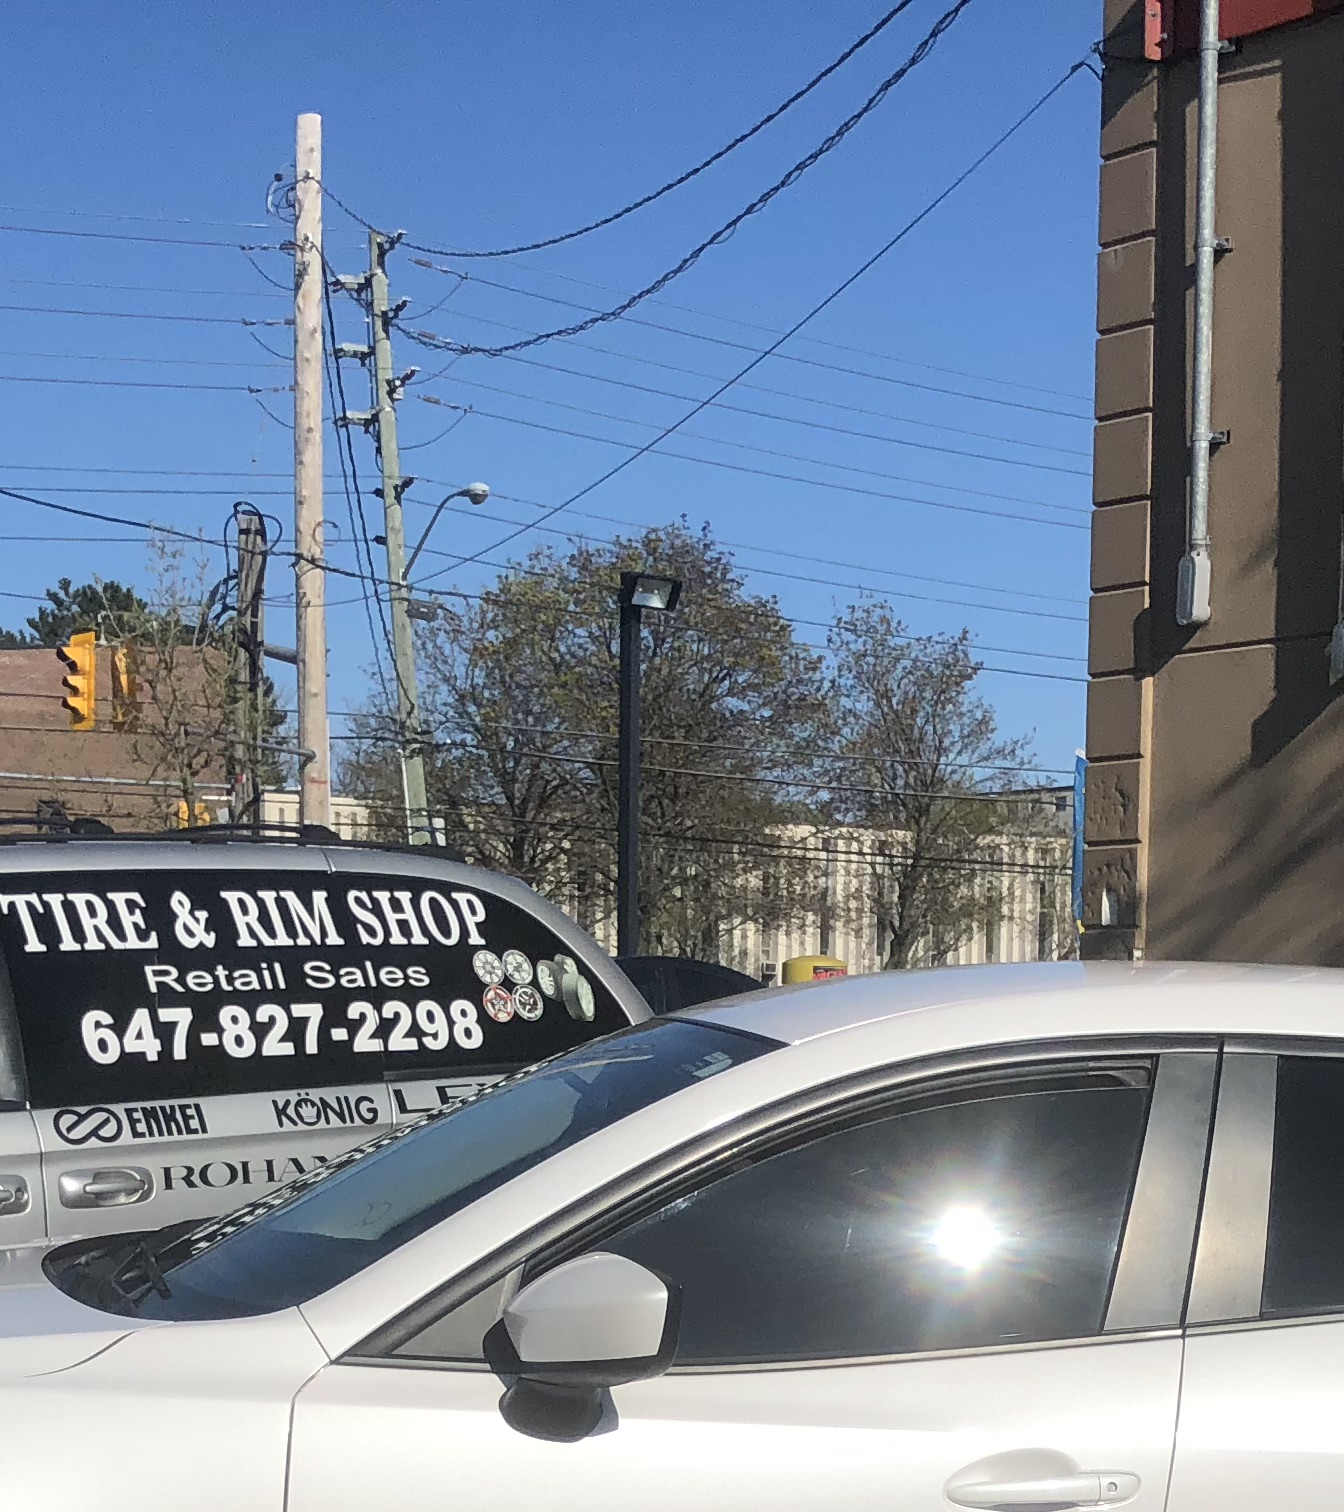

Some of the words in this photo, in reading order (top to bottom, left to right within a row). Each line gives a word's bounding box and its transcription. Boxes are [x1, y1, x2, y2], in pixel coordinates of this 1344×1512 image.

[170, 890, 216, 950] &
[221, 889, 345, 949] RIM
[347, 888, 487, 947] SHOP
[143, 962, 287, 994] Retail
[305, 961, 431, 989] Sales
[80, 999, 484, 1065] 647-827-2298
[271, 1092, 379, 1129] KÖNIG
[393, 1083, 488, 1115] LE
[124, 1103, 209, 1140] ENKEI
